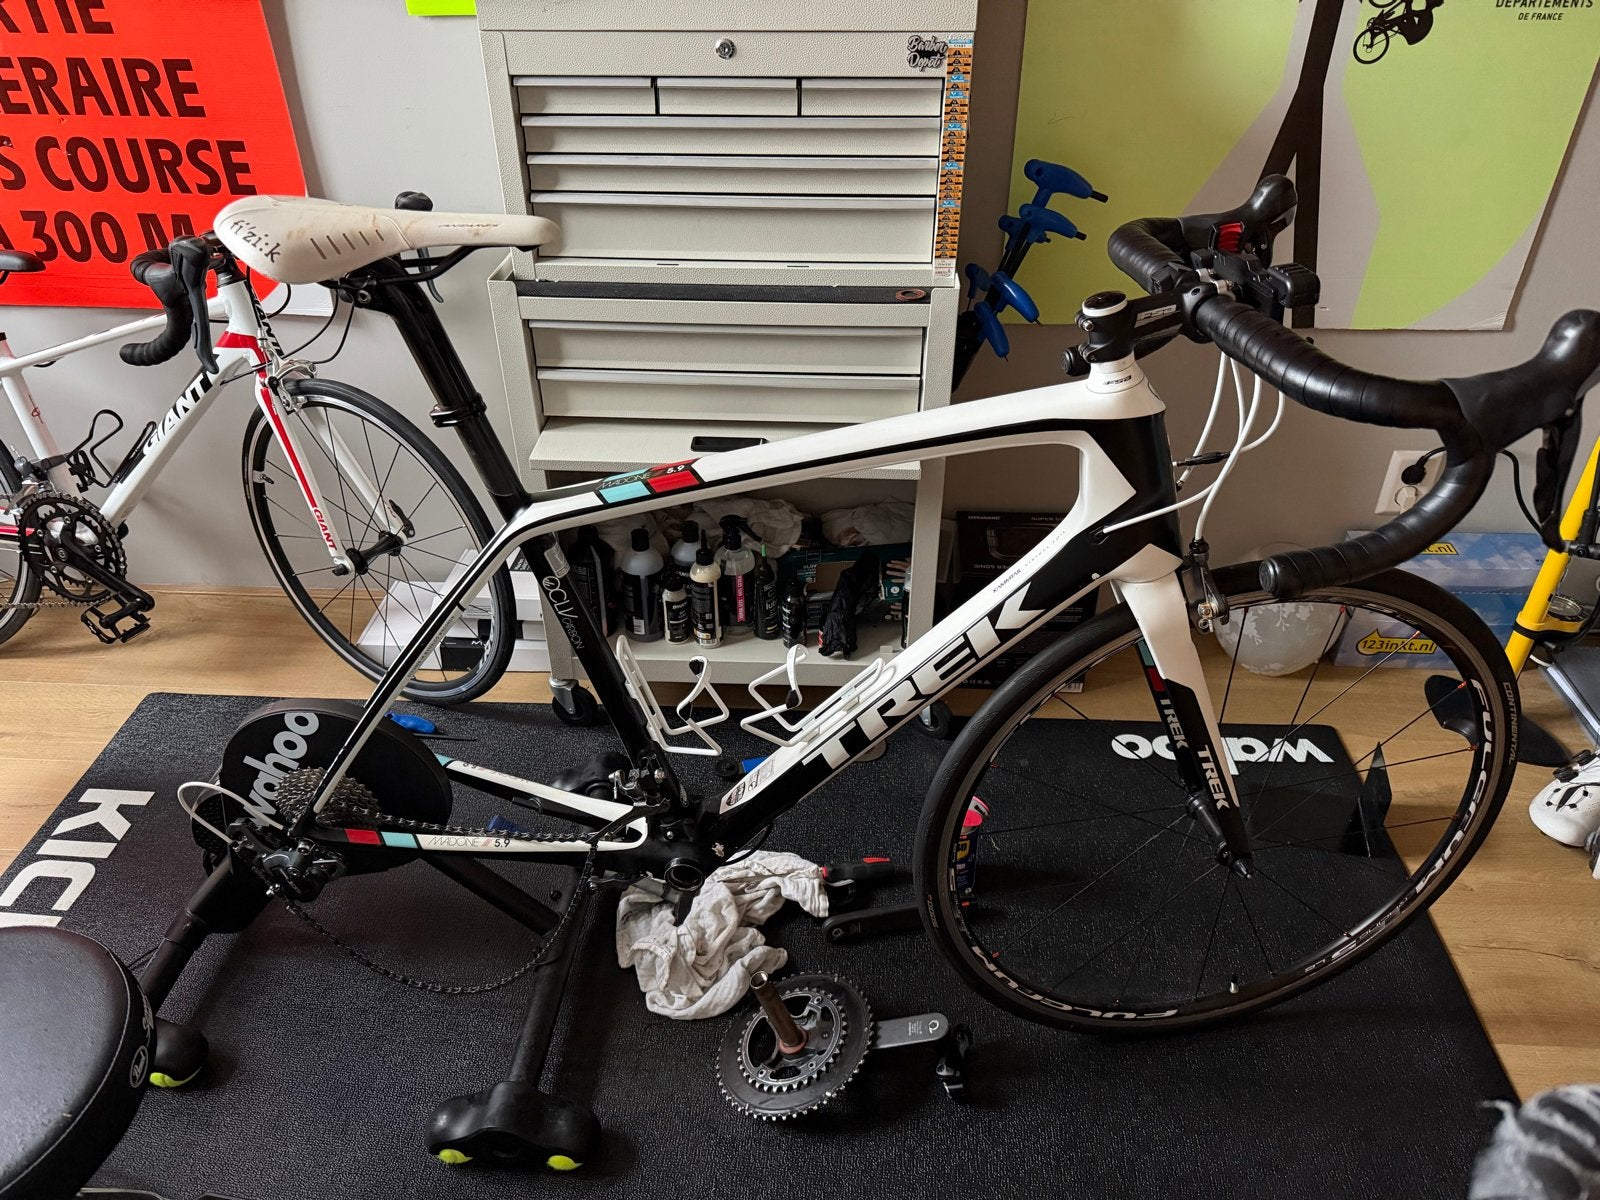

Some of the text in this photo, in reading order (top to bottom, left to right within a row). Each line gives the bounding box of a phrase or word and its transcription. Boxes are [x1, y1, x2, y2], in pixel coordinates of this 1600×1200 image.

[1518, 12, 1564, 20] DE FRANCE
[907, 52, 945, 72] Depot
[908, 35, 948, 53] Barber
[35, 136, 258, 196] COURSE
[20, 210, 128, 264] 300
[667, 464, 685, 474] 5.9
[313, 508, 338, 551] GIANT
[1361, 639, 1435, 652] 123inkt.nl
[801, 581, 1046, 769] TREK
[1160, 699, 1190, 750] TREK
[1502, 681, 1520, 766] CONTINENTAL
[243, 711, 320, 831] wahoo
[1198, 744, 1230, 811] TREK
[0, 788, 156, 928] KIC
[428, 836, 510, 848] MADONE 5.9
